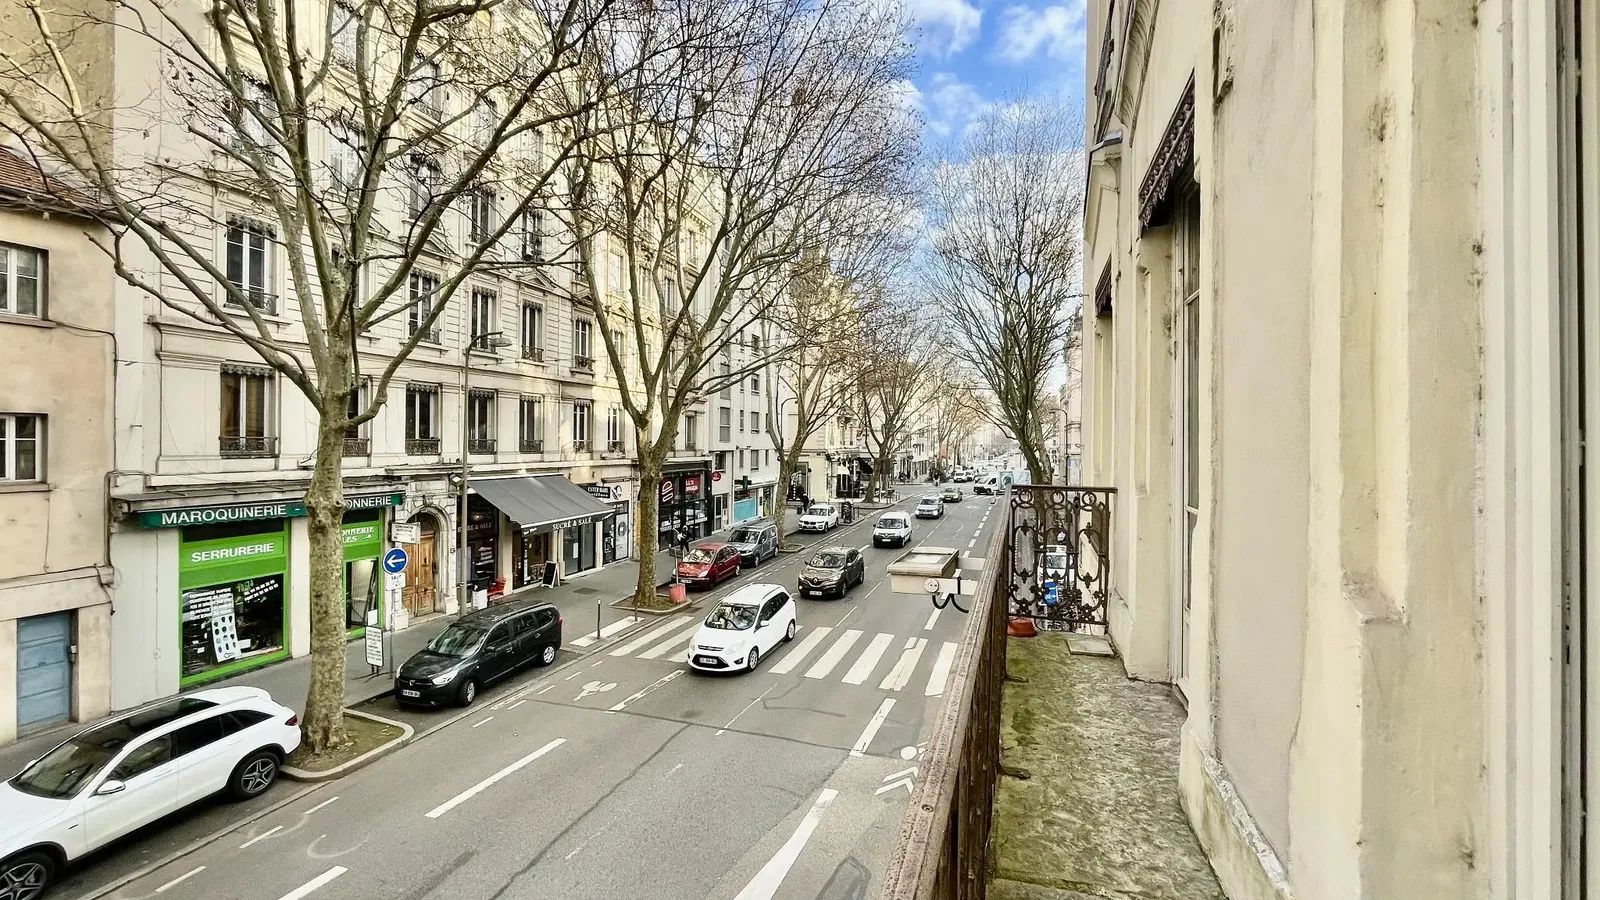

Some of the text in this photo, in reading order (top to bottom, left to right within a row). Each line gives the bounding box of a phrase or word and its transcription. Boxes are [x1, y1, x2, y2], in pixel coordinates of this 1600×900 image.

[161, 504, 287, 525] MAROQUINERIE
[552, 516, 592, 531] SUCRÉ & SALÉ
[341, 526, 375, 536] ONNERIE
[191, 542, 275, 563] SERRURERIE
